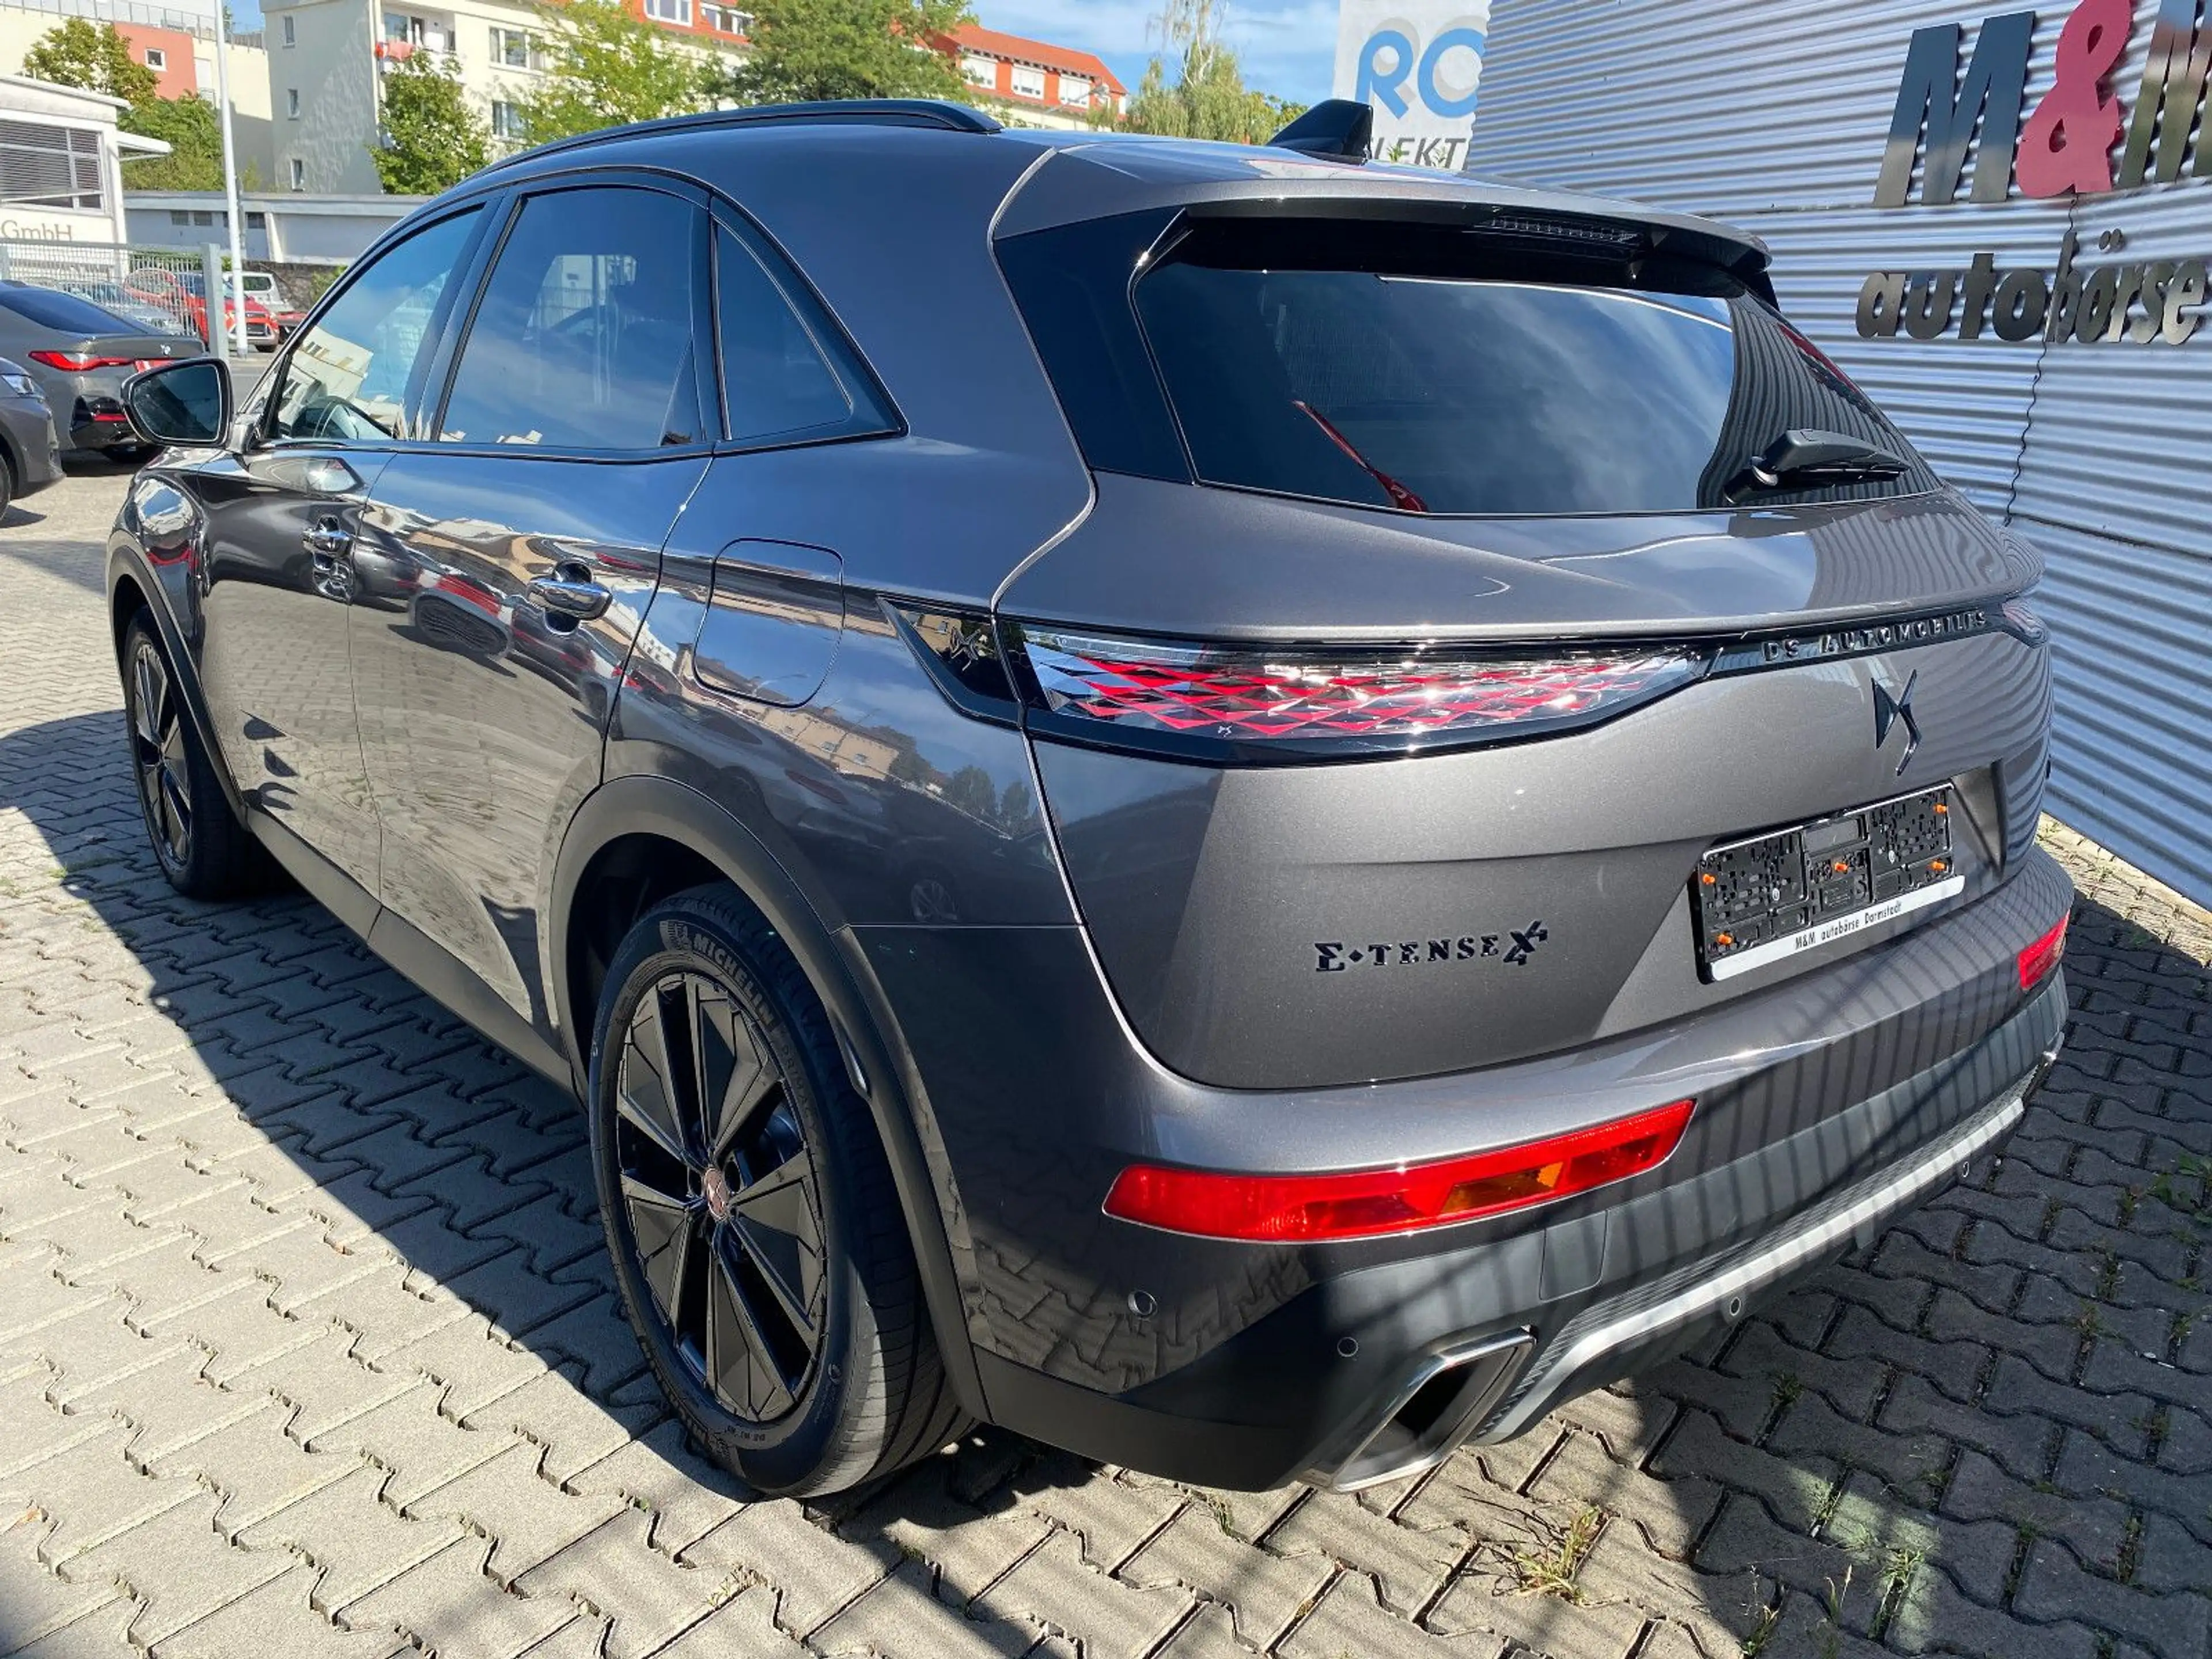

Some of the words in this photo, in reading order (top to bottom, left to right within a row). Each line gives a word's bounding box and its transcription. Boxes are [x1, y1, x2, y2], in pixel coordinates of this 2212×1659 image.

[1, 219, 72, 242] GmbH
[1855, 229, 2207, 344] autobörse
[1761, 638, 1800, 662] DS
[1819, 611, 1986, 654] AUTOMOBILES
[1795, 931, 1816, 949] M&M
[693, 933, 775, 1026] MICHELIN
